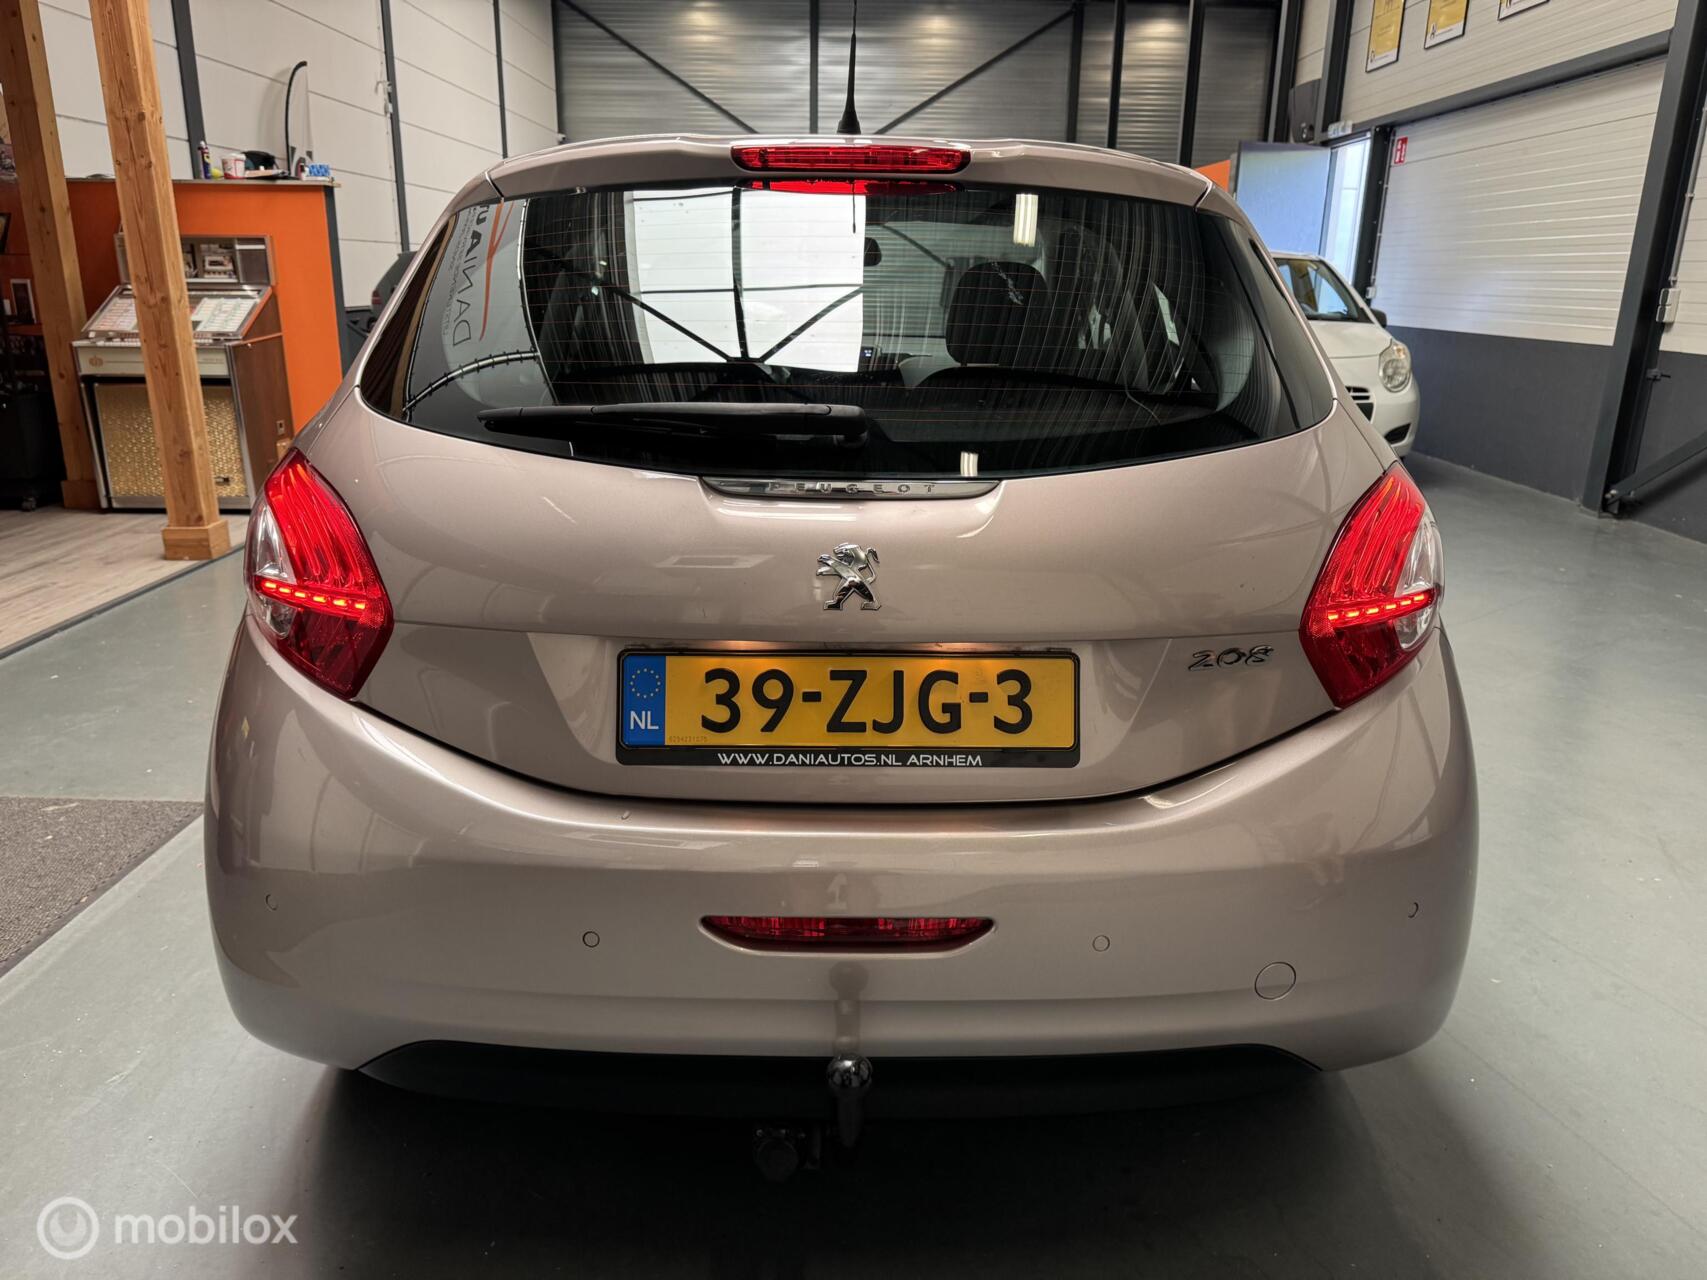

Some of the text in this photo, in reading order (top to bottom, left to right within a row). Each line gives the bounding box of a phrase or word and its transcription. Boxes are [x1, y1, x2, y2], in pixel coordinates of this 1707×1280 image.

[769, 482, 936, 495] PEUGEOT
[1187, 645, 1274, 671] 208
[700, 669, 1033, 734] 39-ZJG-3
[629, 710, 660, 730] NL
[717, 753, 983, 767] WWW.DANIAUTOS.NL ARNHEM
